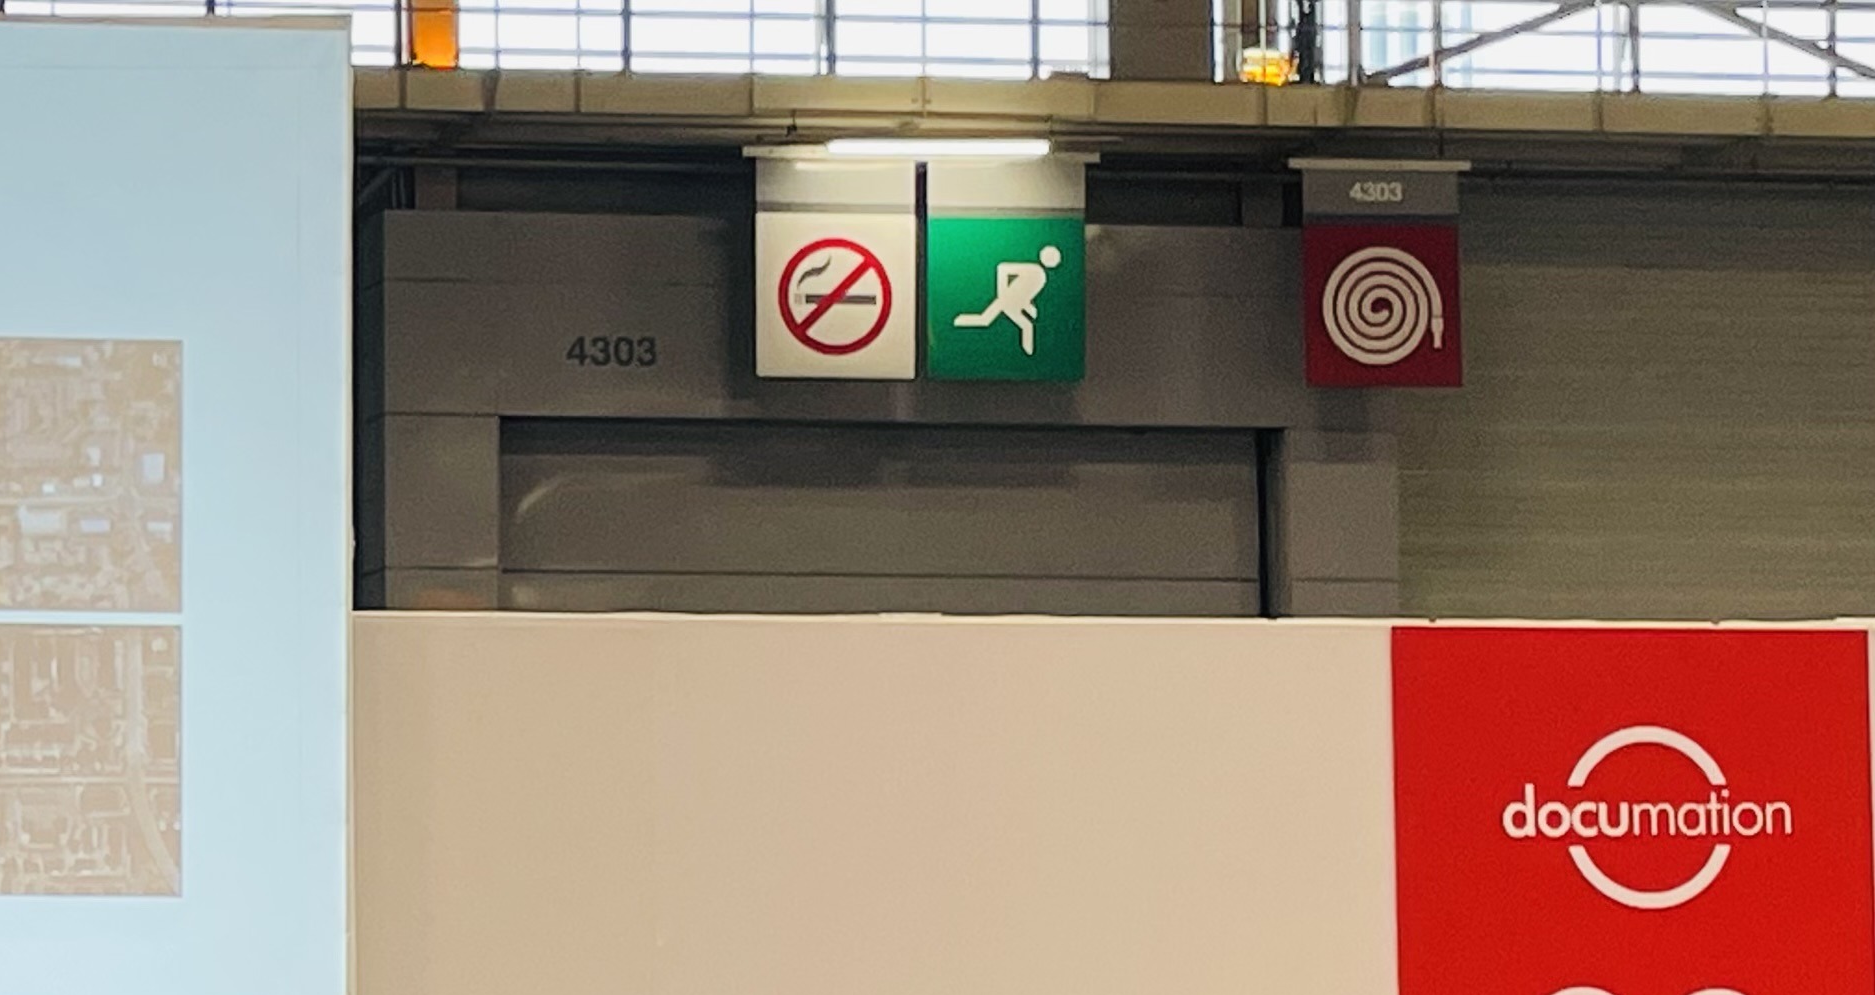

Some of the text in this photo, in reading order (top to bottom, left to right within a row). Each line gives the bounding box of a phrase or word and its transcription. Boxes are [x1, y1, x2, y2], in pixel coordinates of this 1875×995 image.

[1349, 181, 1403, 202] 4303
[565, 336, 657, 367] 4303
[1502, 782, 1793, 838] documation
